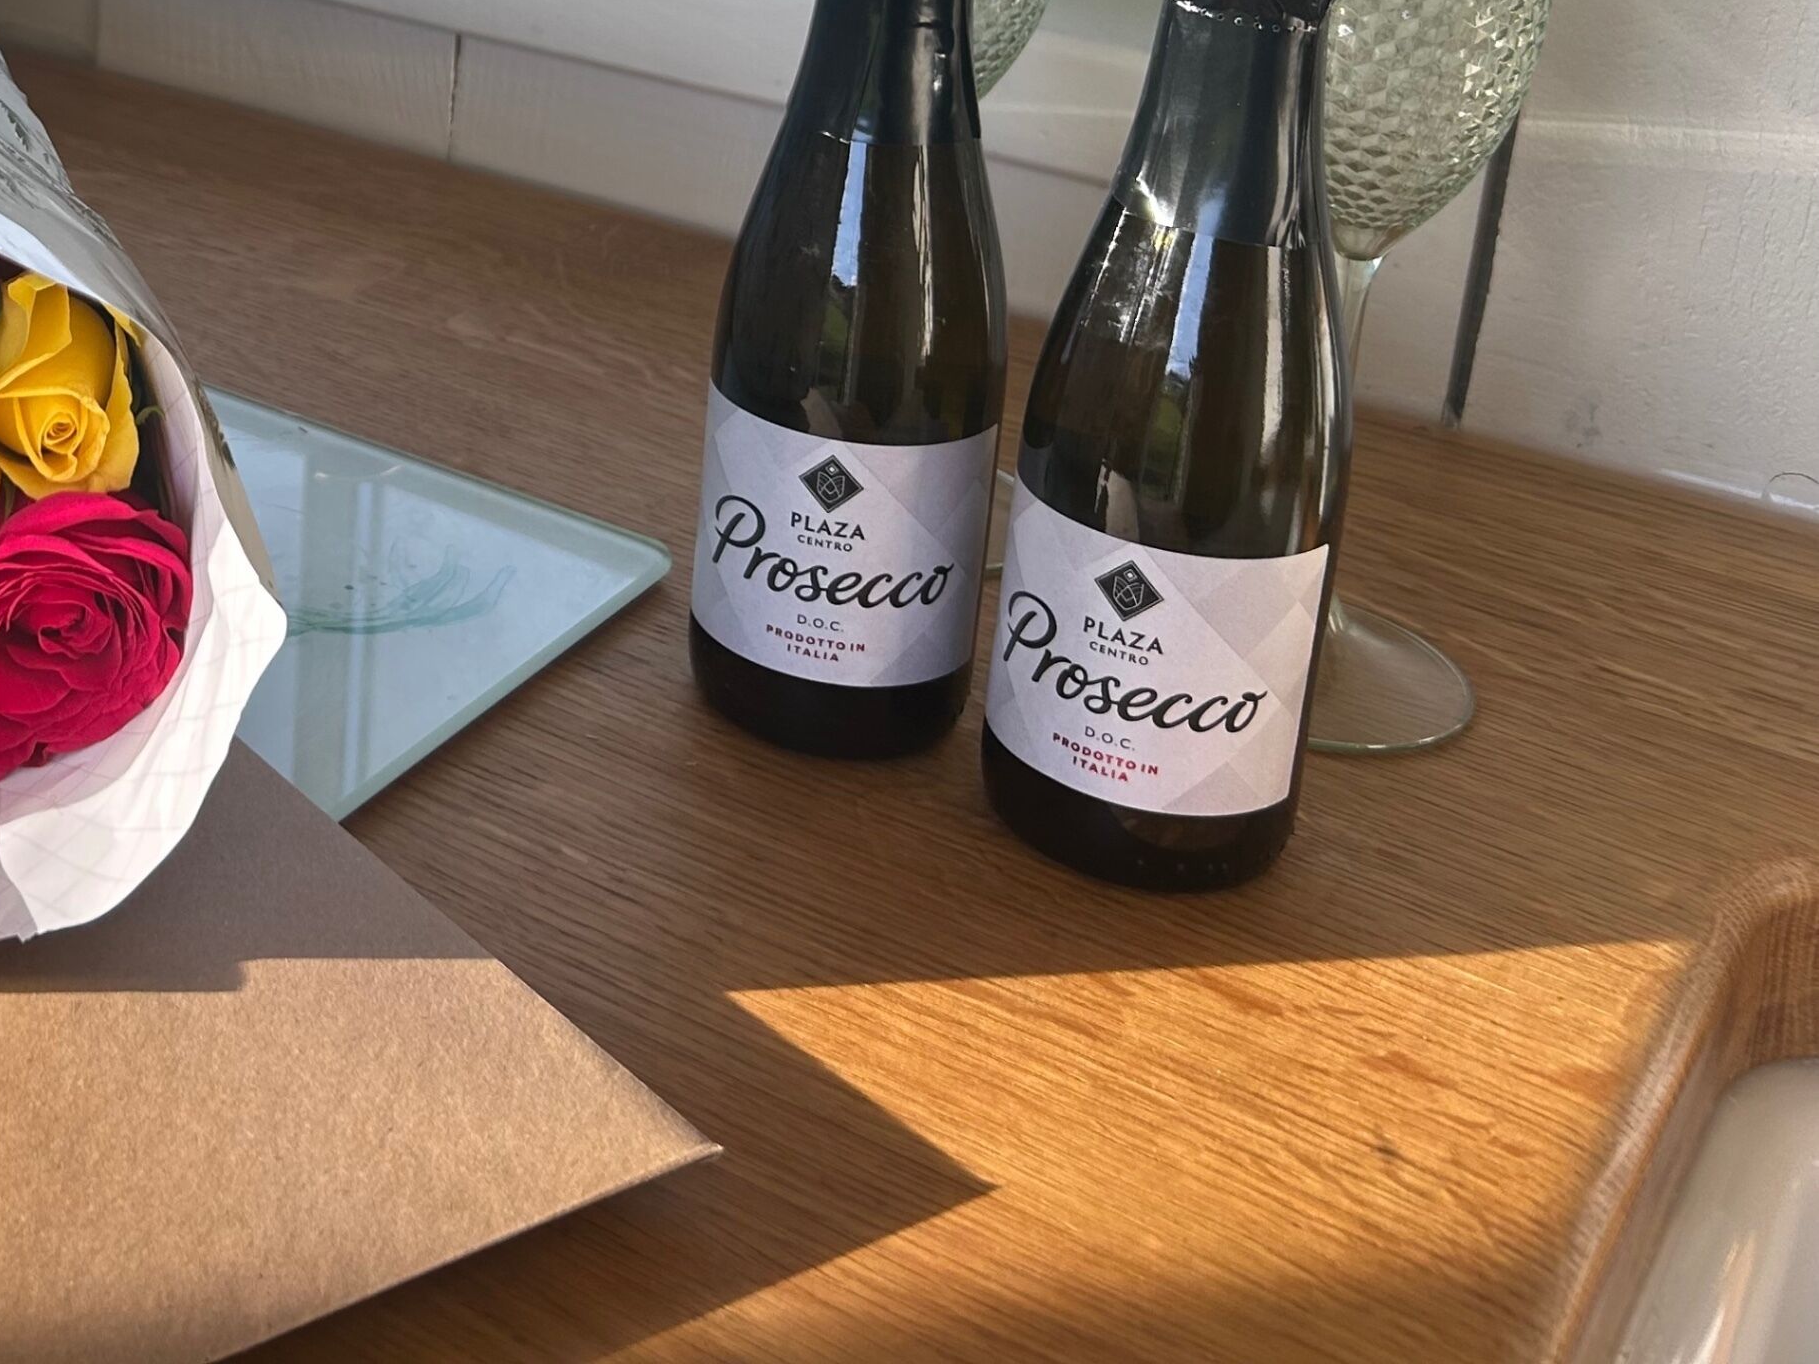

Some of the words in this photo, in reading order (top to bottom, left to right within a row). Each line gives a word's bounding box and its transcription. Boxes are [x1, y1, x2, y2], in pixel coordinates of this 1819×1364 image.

[791, 512, 866, 541] PLAZA
[711, 495, 955, 609] Prosecco
[797, 534, 853, 553] CENTRO
[797, 613, 844, 633] D.O.C.
[1083, 616, 1165, 656] PLAZA
[766, 624, 846, 651] PRODOTTO
[850, 642, 866, 653] IN
[787, 643, 839, 662] ITALIA
[1003, 591, 1268, 733] Prosecco
[1089, 641, 1149, 666] CENTRO
[1085, 726, 1135, 751] D.O.C.
[1052, 733, 1136, 770] PRODOTTO
[1141, 763, 1159, 776] IN
[1072, 756, 1129, 783] ITALIA
